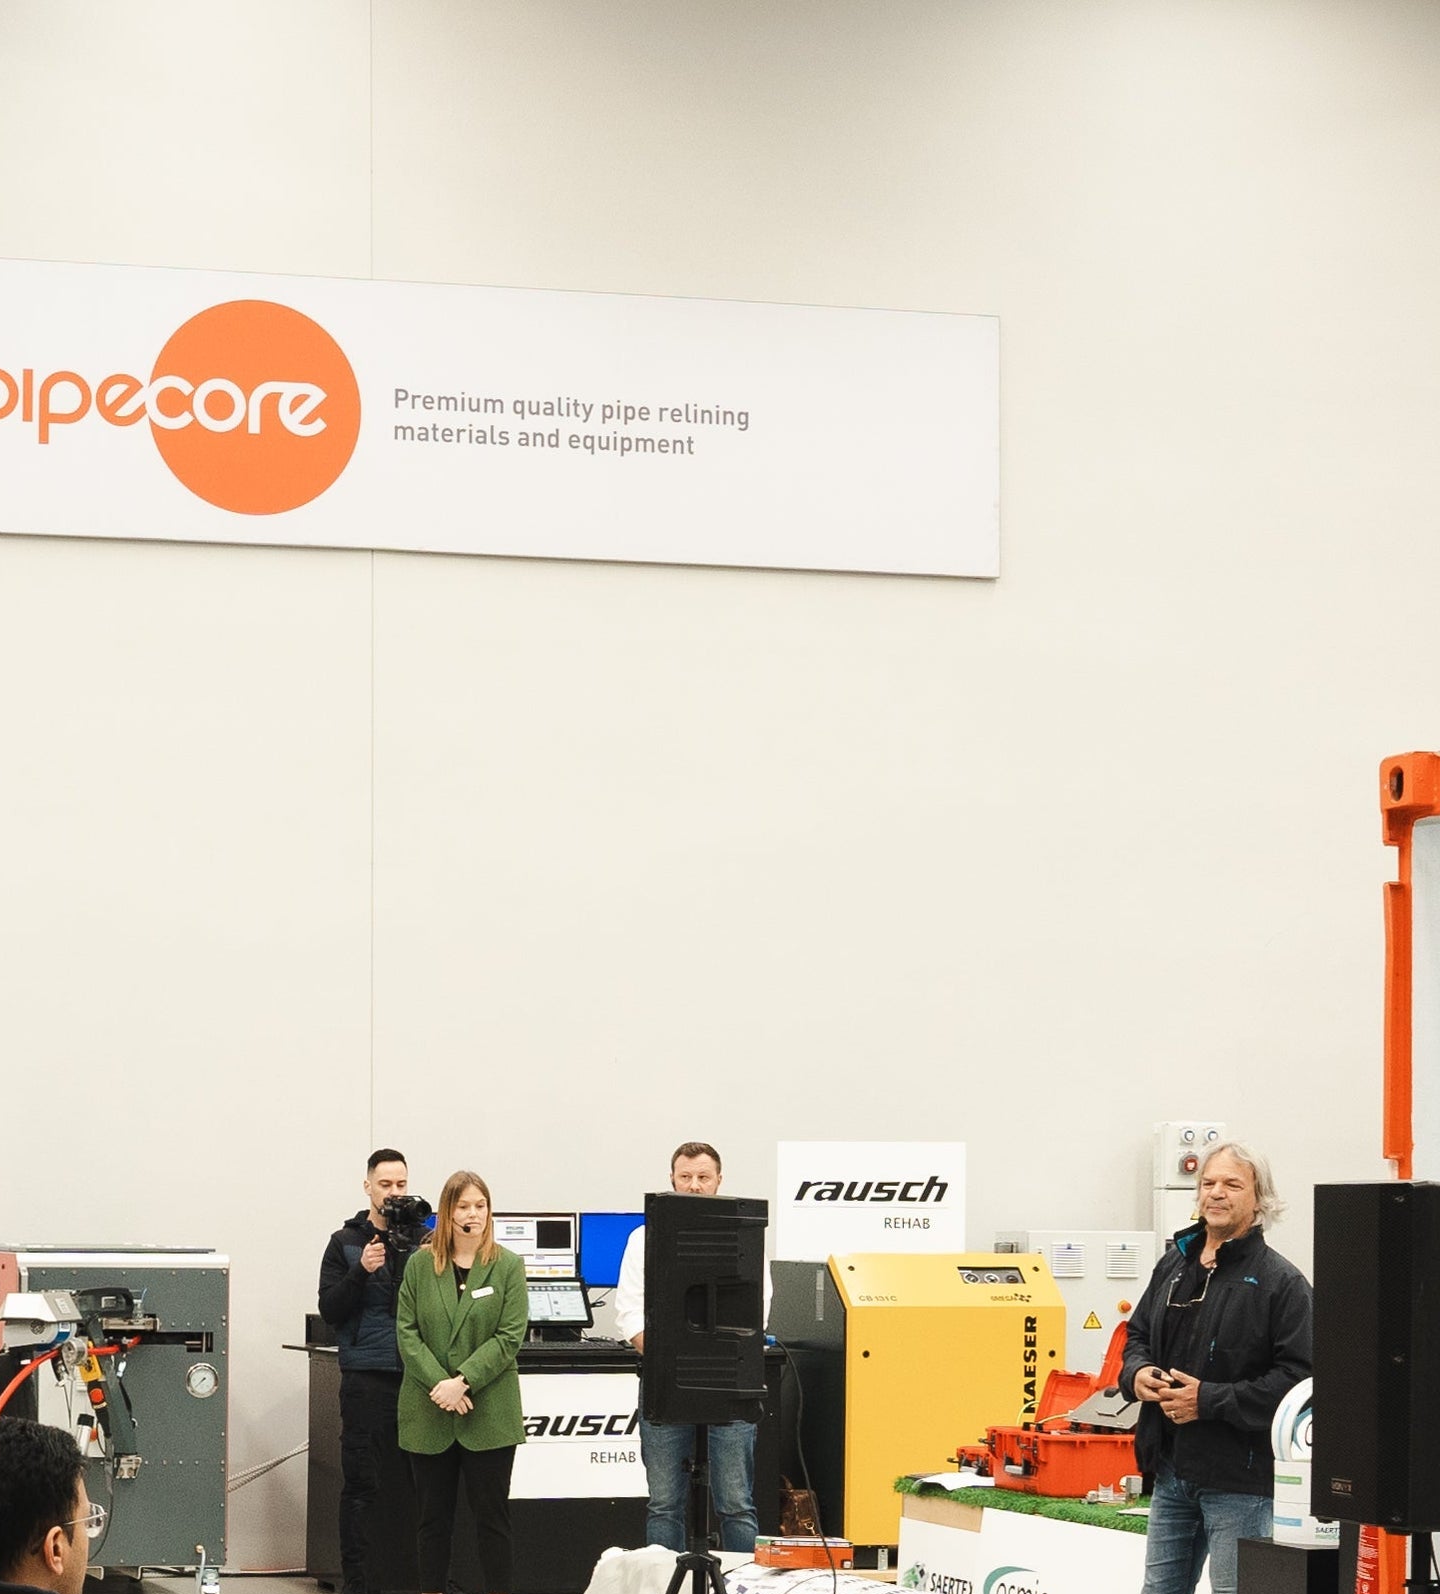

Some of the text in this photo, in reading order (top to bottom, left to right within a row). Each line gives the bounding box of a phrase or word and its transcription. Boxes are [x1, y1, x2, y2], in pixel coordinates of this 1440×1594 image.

[394, 388, 750, 431] Premium quality pipe relining
[394, 422, 694, 457] materials and equipment
[794, 1176, 949, 1203] rausch
[884, 1217, 931, 1230] REHAB
[1023, 1315, 1038, 1415] KAESER
[522, 1408, 639, 1437] ausc
[590, 1451, 637, 1464] REHAB
